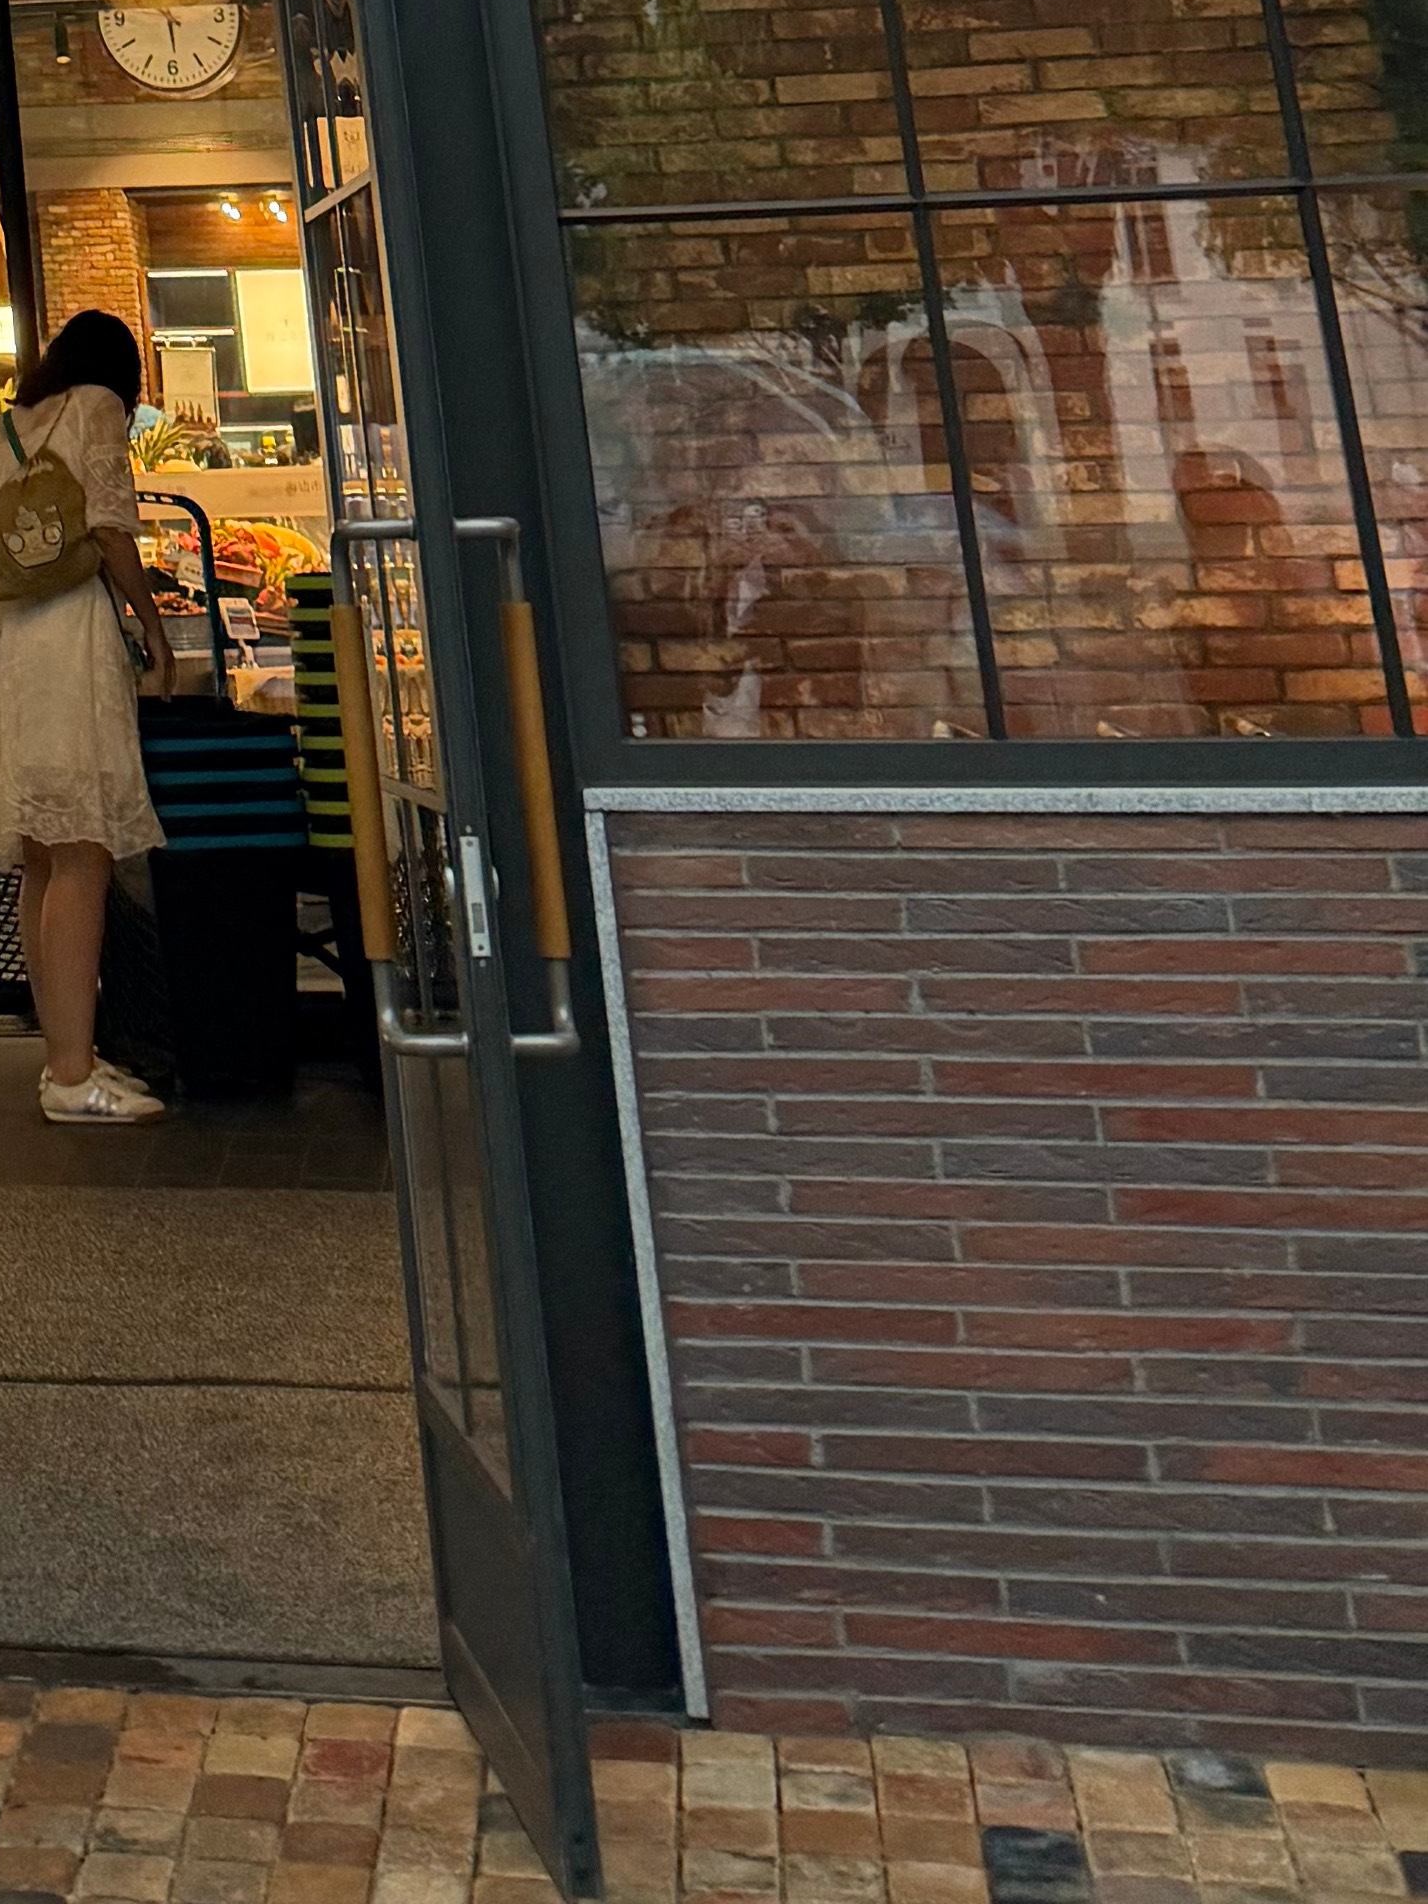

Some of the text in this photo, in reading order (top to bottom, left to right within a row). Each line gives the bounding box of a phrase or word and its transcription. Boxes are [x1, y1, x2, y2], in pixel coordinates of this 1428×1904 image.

[113, 10, 125, 27] 9
[213, 6, 225, 24] 3
[167, 59, 179, 76] 6
